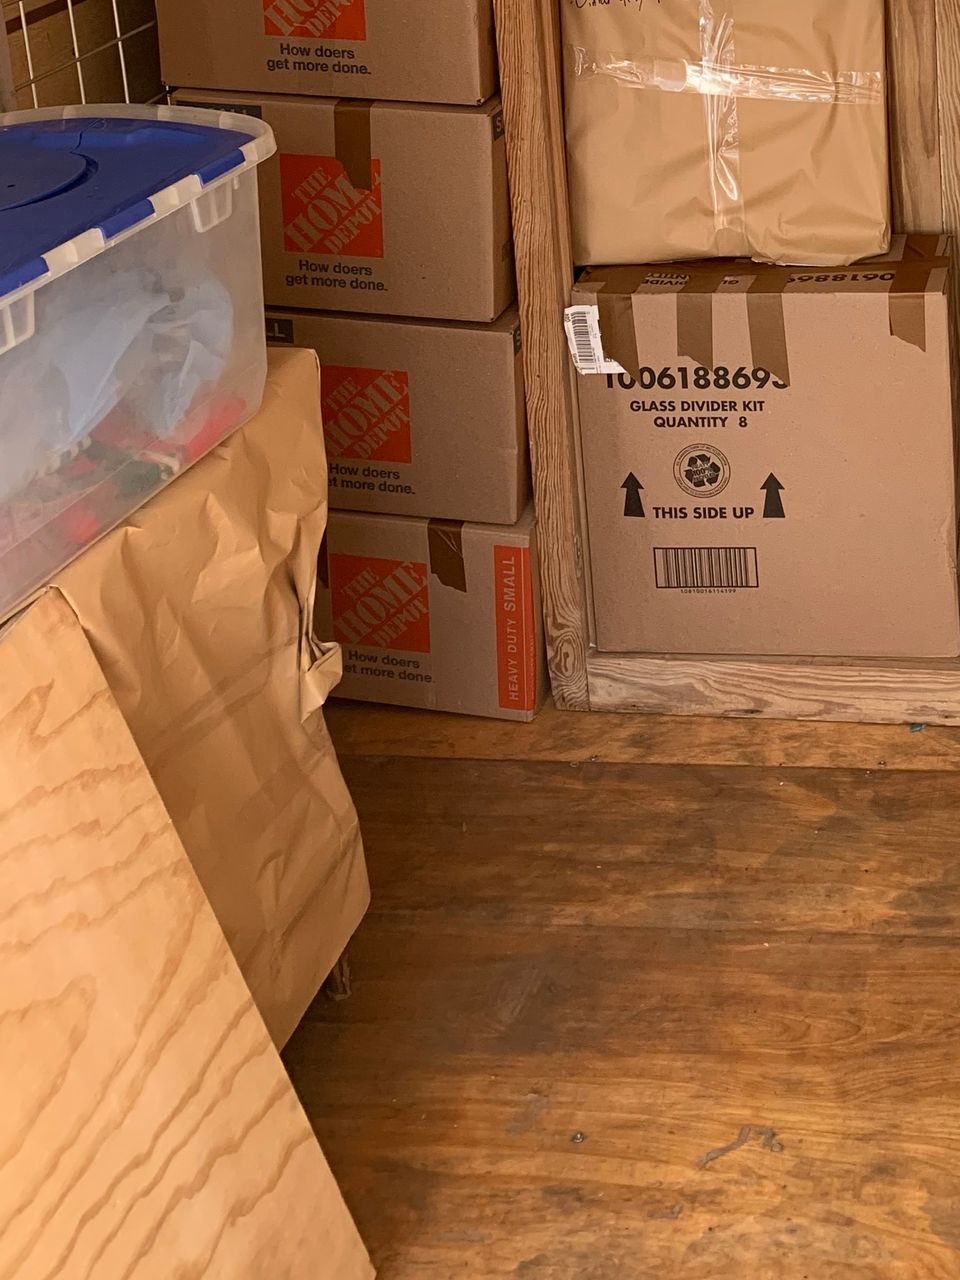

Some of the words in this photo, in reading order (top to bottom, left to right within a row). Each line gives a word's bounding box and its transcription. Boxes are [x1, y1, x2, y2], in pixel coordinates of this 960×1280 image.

[279, 42, 311, 57] How
[314, 43, 355, 59] doers
[266, 58, 290, 72] get
[293, 60, 329, 72] more
[291, 166, 333, 204] THE
[284, 172, 383, 253] HOM
[324, 194, 383, 254] DEPOT
[299, 259, 329, 274] How
[333, 261, 372, 277] doers
[787, 272, 896, 283] 061886
[285, 273, 308, 287] get
[311, 276, 347, 289] more
[322, 376, 362, 412] THE
[630, 400, 676, 412] GLASS
[680, 400, 738, 412] DIVIDER
[743, 400, 765, 412] KIT
[653, 416, 729, 428] QUANTITY
[738, 416, 748, 428] 8
[352, 406, 410, 459] DEPOT
[329, 463, 362, 476] How
[363, 466, 400, 481] doers
[327, 477, 338, 487] et
[341, 478, 376, 491] more
[652, 507, 688, 519] THIS
[692, 507, 728, 519] SIDE
[732, 507, 754, 519] UP
[340, 567, 380, 598] THE
[503, 556, 515, 613] SMALL
[333, 562, 427, 645] HOME
[369, 597, 429, 648] DEPOT
[506, 619, 518, 654] DUTY
[348, 650, 378, 664] How
[381, 654, 420, 669] doers
[344, 663, 357, 674] et
[360, 666, 395, 679] more
[508, 657, 519, 701] HEAVY
